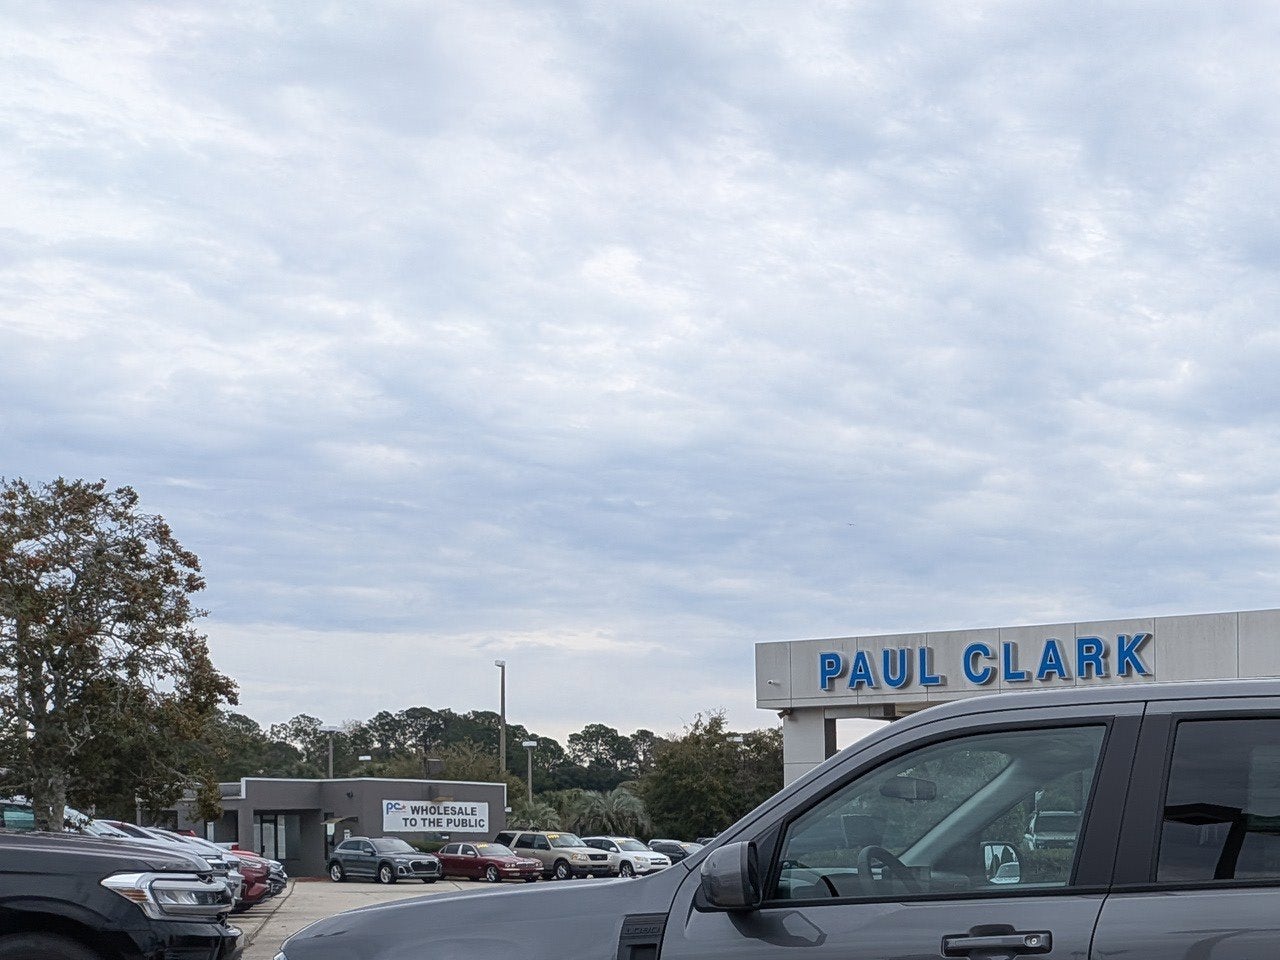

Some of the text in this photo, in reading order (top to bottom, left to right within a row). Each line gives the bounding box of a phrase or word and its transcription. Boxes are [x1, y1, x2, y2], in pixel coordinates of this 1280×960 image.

[819, 632, 1154, 691] PAUL CLARK
[410, 806, 478, 816] WHOLESALE
[402, 818, 485, 828] TO THE PUBLIC
